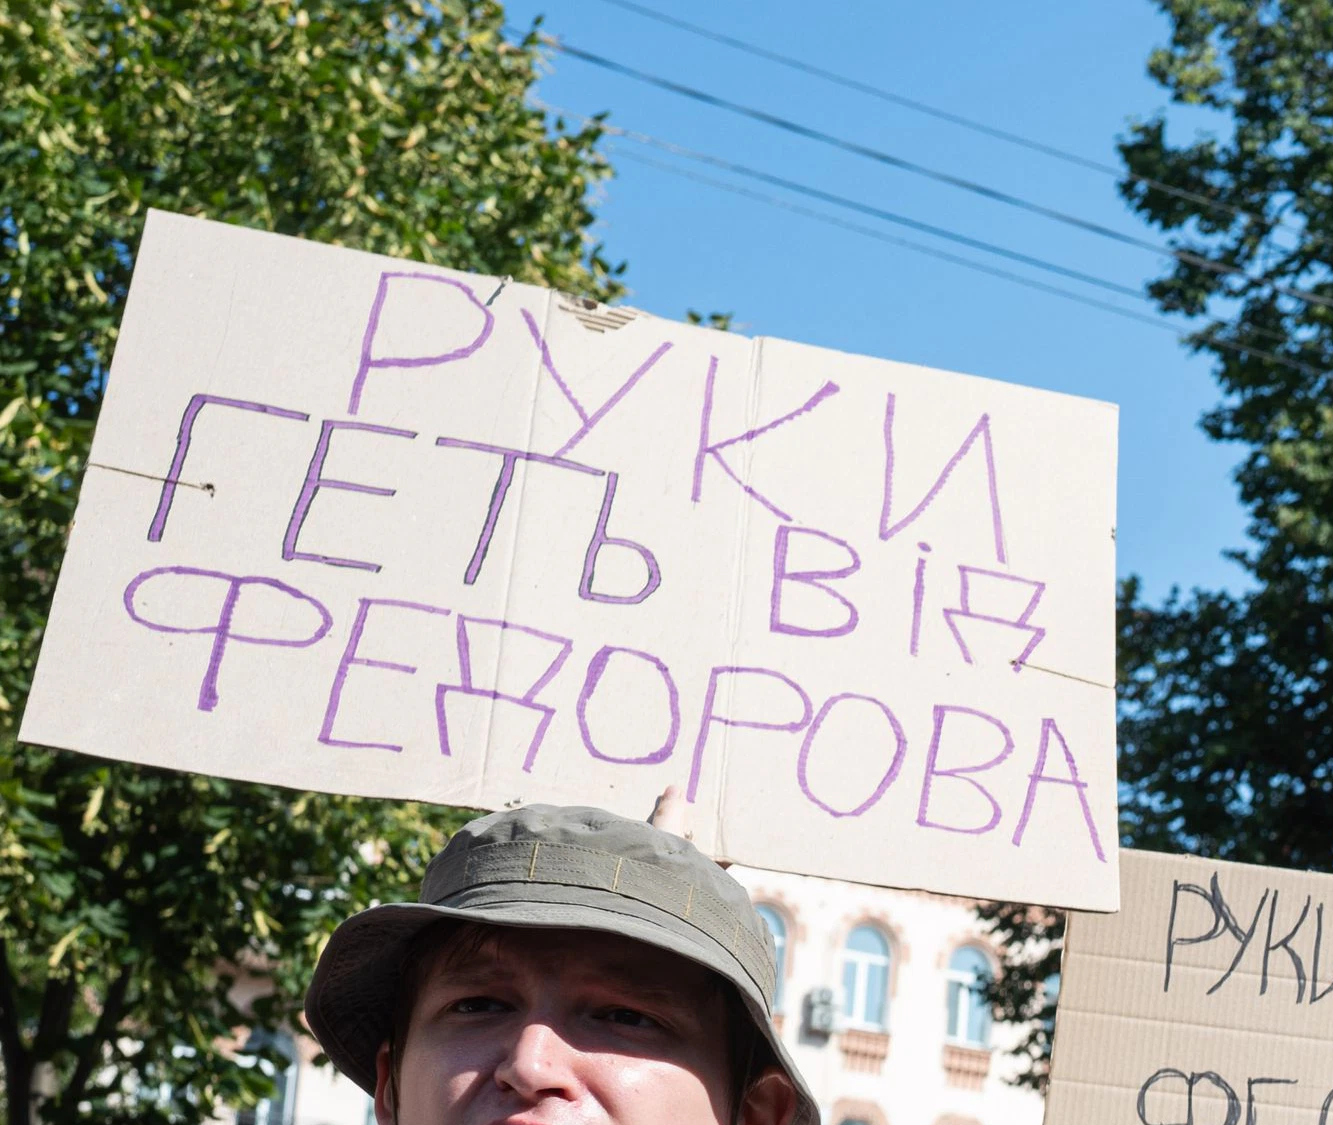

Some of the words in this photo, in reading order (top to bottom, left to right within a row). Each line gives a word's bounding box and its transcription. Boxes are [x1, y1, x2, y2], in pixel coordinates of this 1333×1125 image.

[147, 393, 662, 604] ГЕТЬ
[346, 271, 1008, 564] РУКИ
[123, 564, 1108, 864] ФЕДОРОВА
